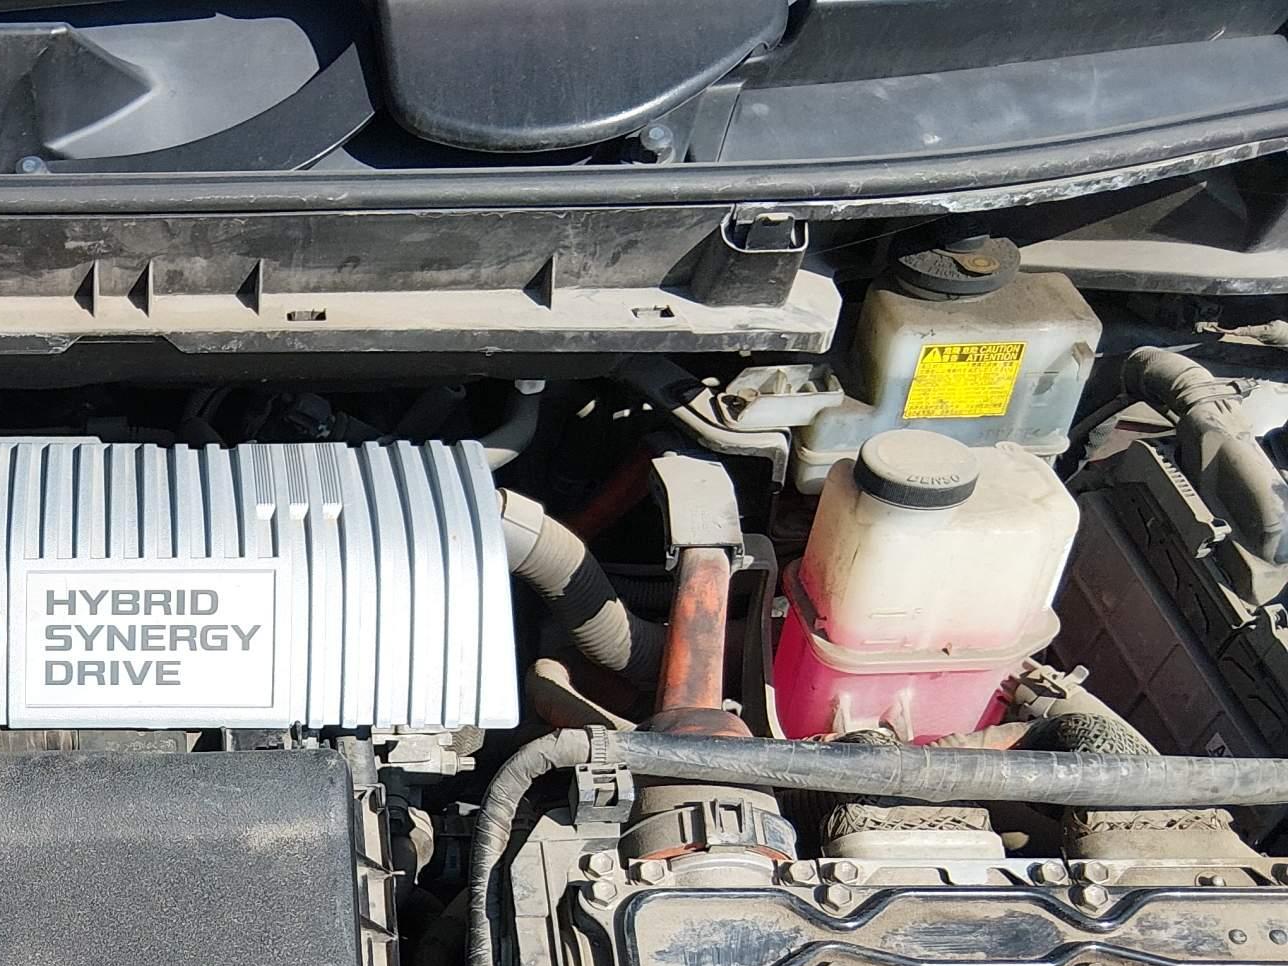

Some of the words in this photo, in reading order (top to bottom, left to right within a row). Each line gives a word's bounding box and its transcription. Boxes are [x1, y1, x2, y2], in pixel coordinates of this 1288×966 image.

[966, 353, 1018, 362] ATTENTION
[979, 344, 1021, 353] CAUTION
[45, 589, 219, 616] HYBRID
[44, 624, 262, 651] SYNERGY
[44, 660, 181, 686] DRIVE
